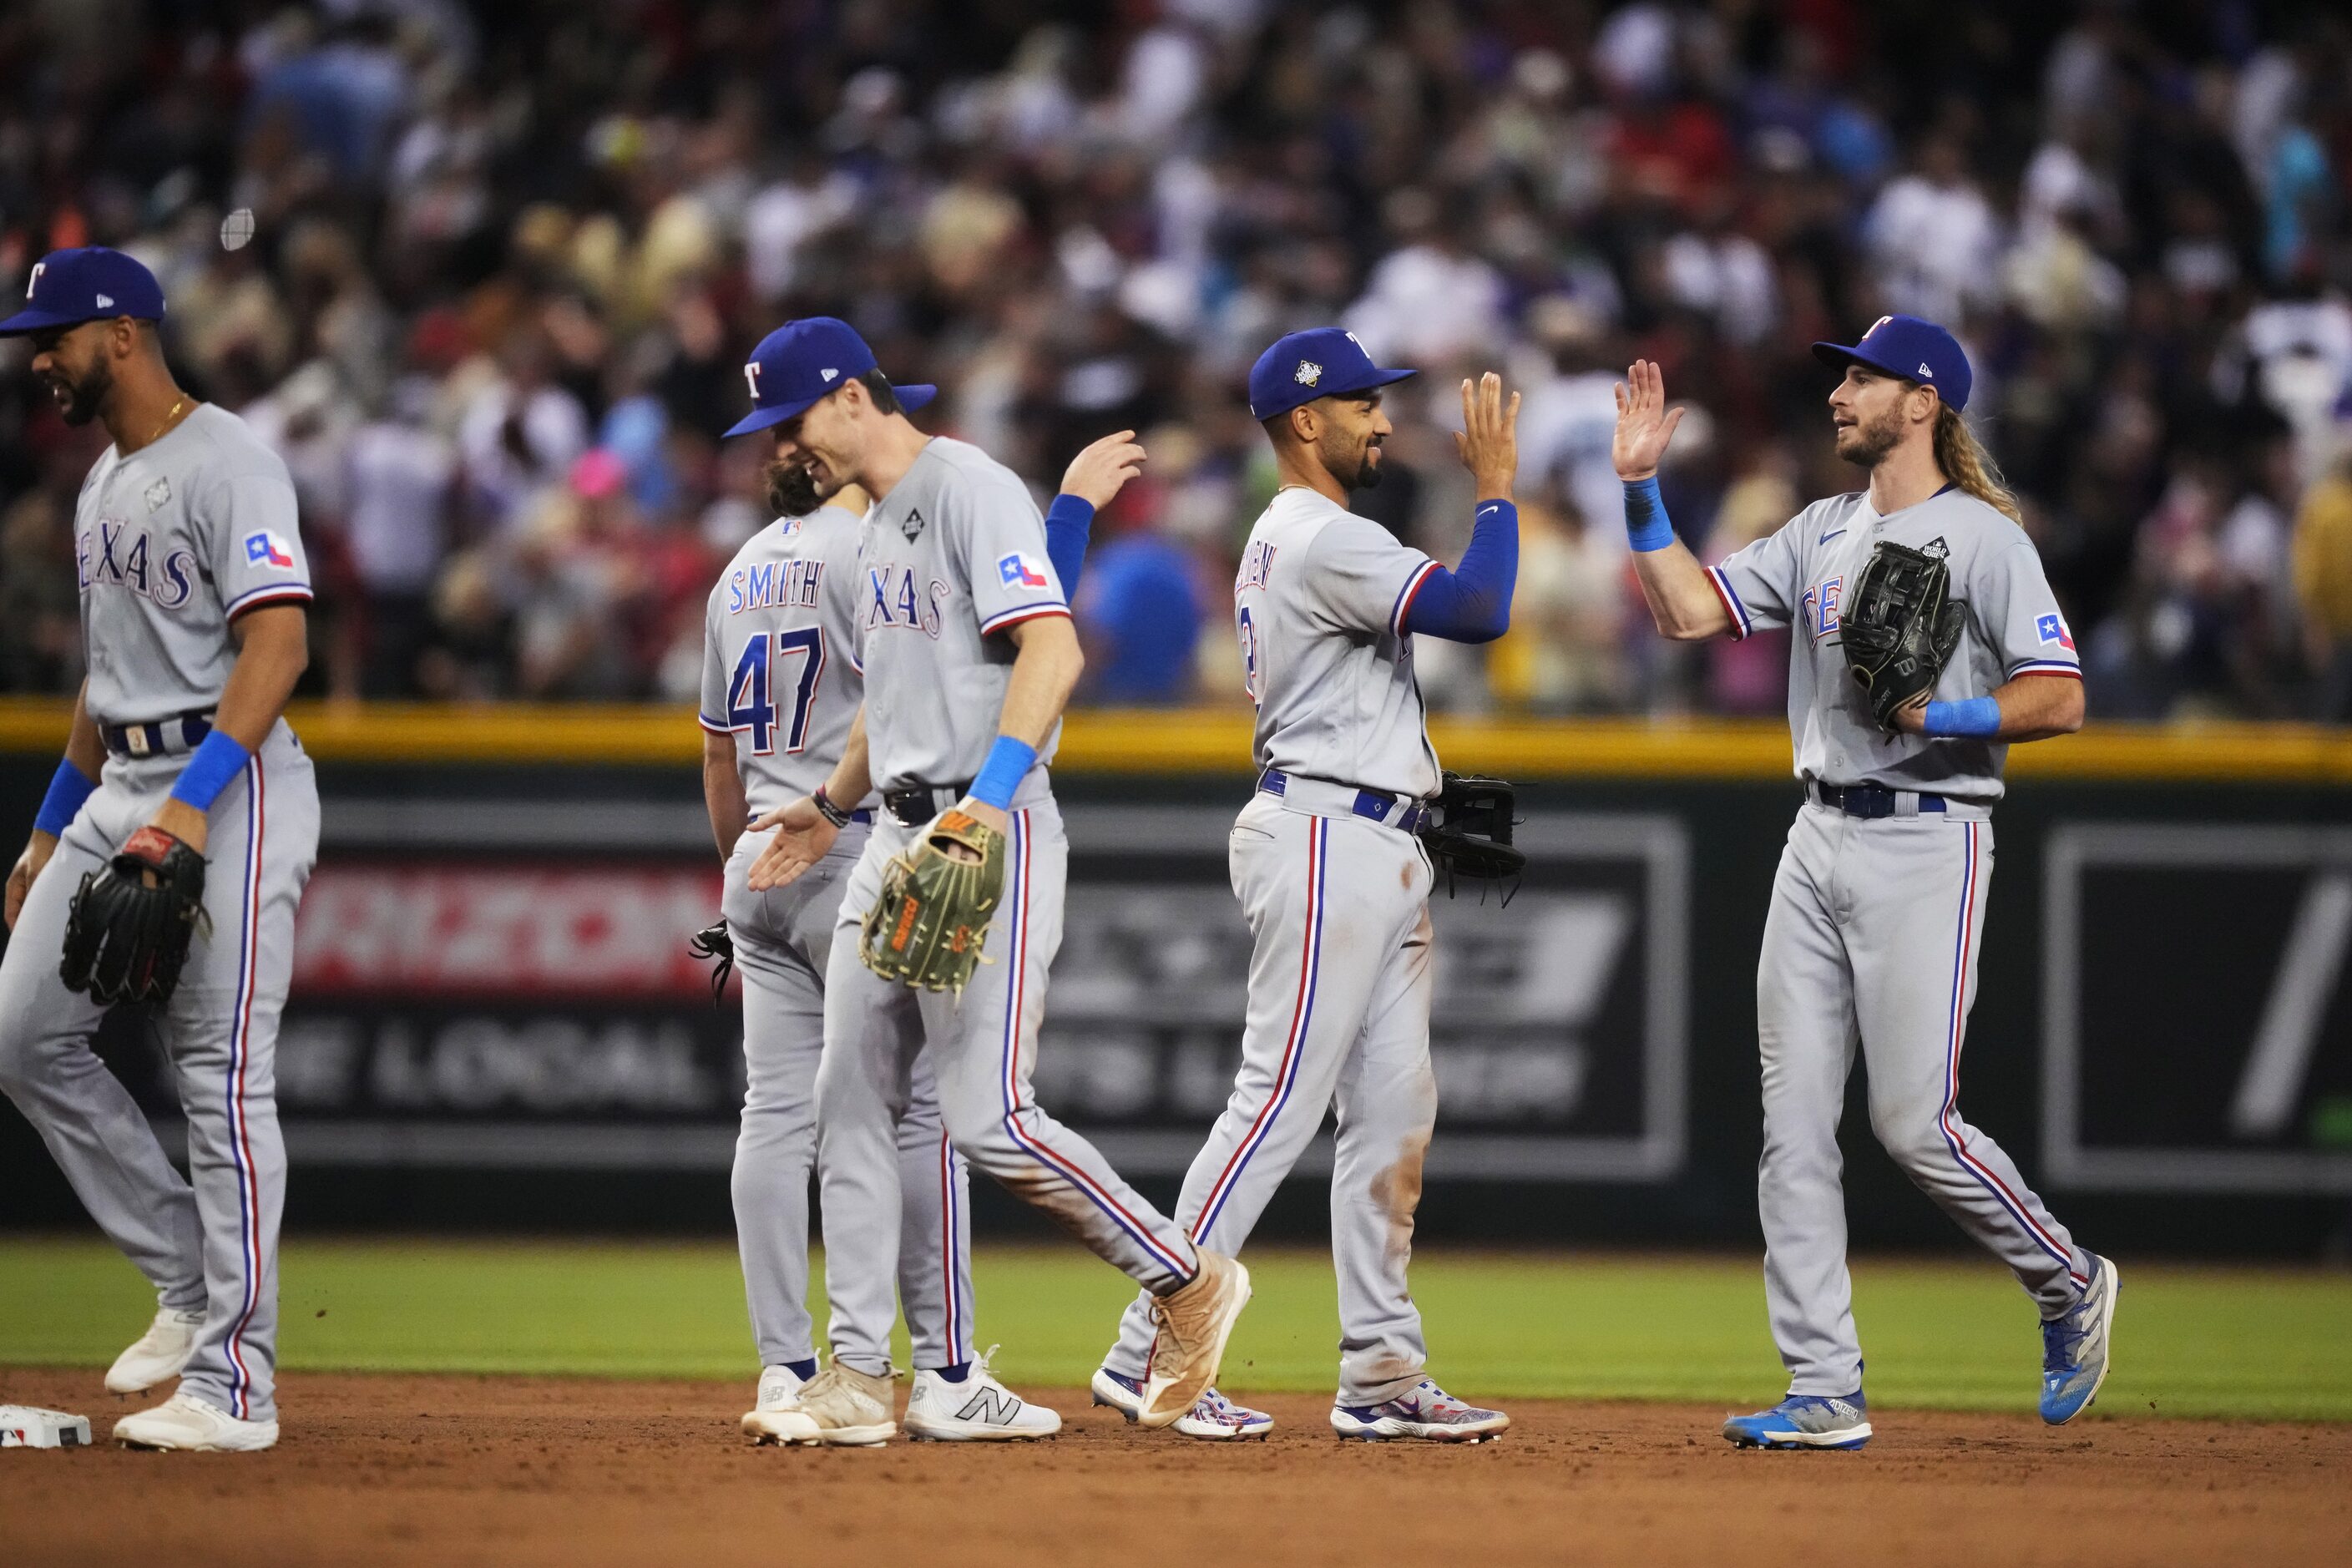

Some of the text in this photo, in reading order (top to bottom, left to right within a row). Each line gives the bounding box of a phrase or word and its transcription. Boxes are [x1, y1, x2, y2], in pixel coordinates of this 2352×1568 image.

[745, 362, 761, 400] T
[1924, 544, 1947, 554] WORLD
[729, 559, 824, 615] SMITH
[726, 624, 827, 757] 47
